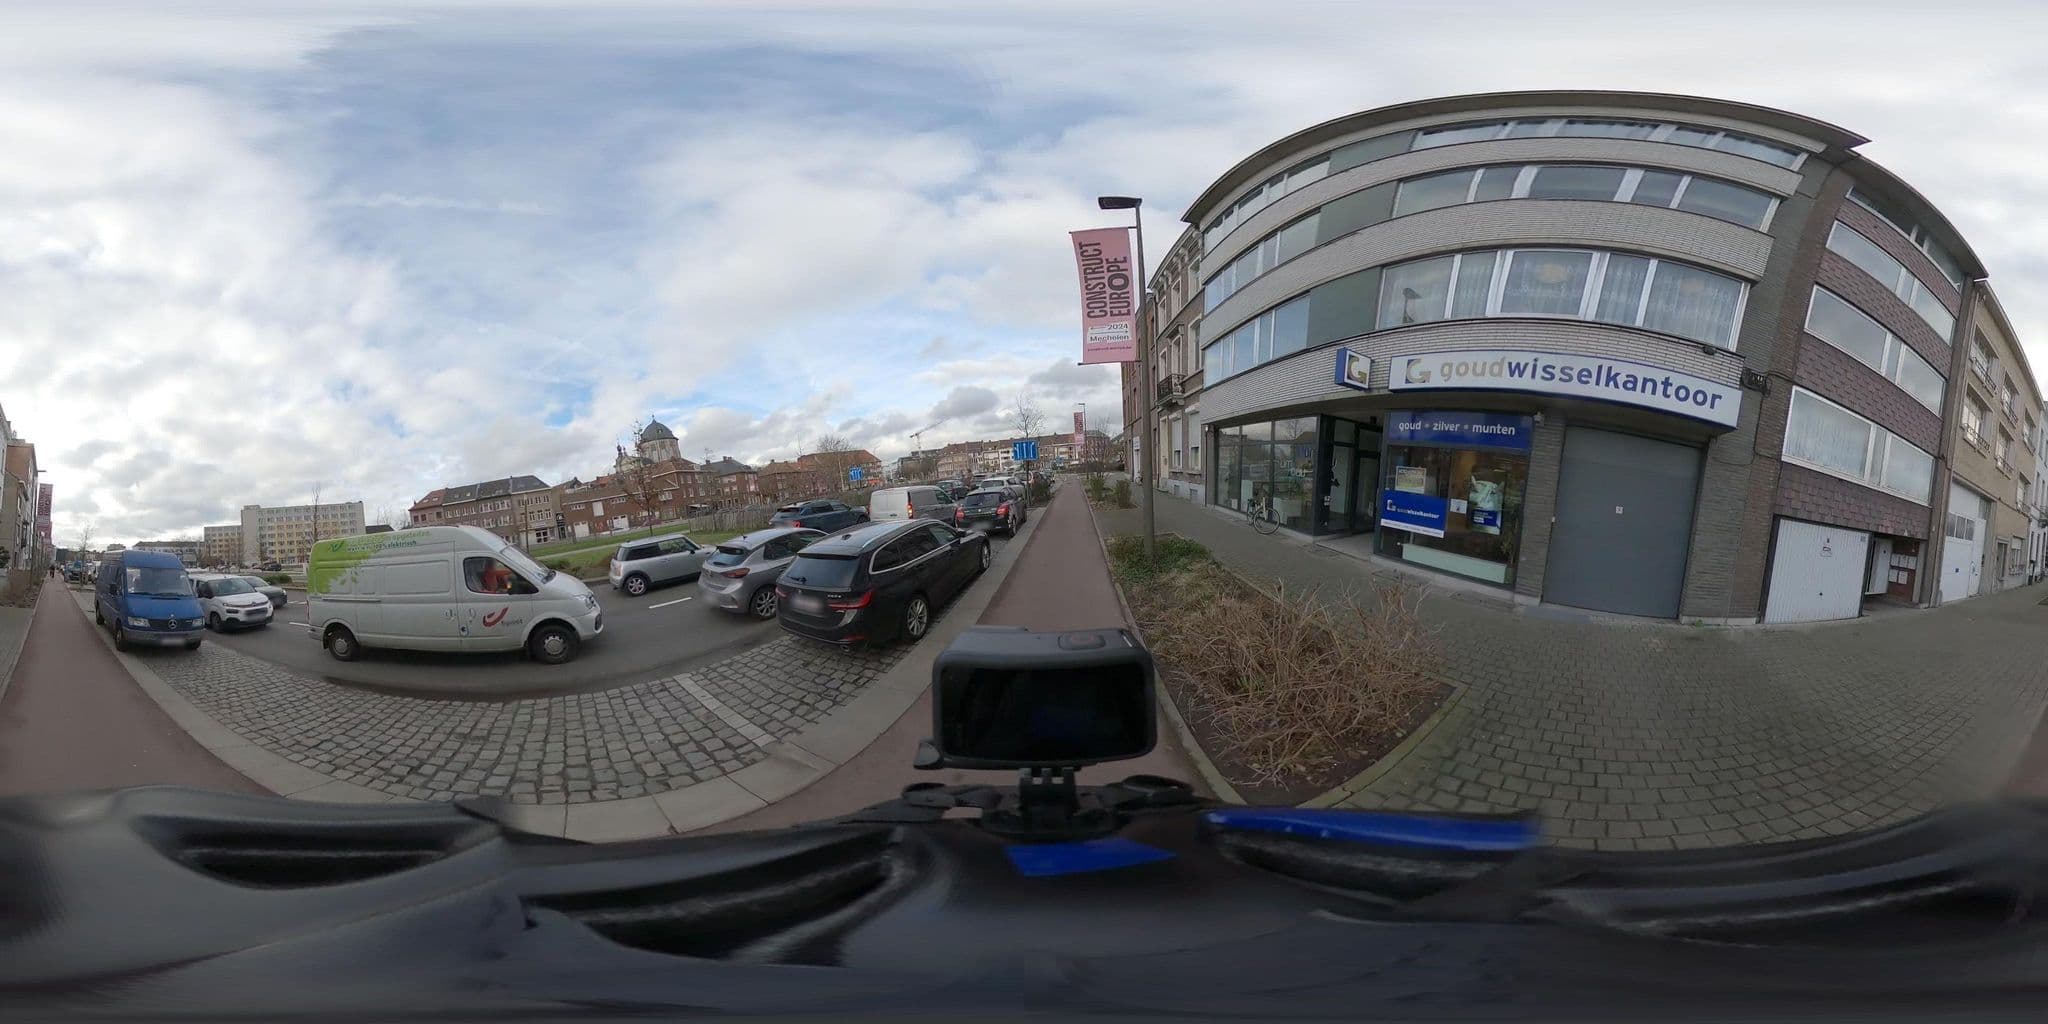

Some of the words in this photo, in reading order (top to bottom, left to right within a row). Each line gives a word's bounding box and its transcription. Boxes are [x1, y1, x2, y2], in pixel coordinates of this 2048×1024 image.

[1079, 242, 1108, 319] CONSTRUCT
[1106, 256, 1131, 317] EUROPE
[1089, 334, 1130, 342] Mechelen
[1440, 356, 1723, 410] goudwisselkantoor
[1398, 420, 1422, 431] goud
[1432, 421, 1461, 431] zilver
[1472, 423, 1516, 436] munten
